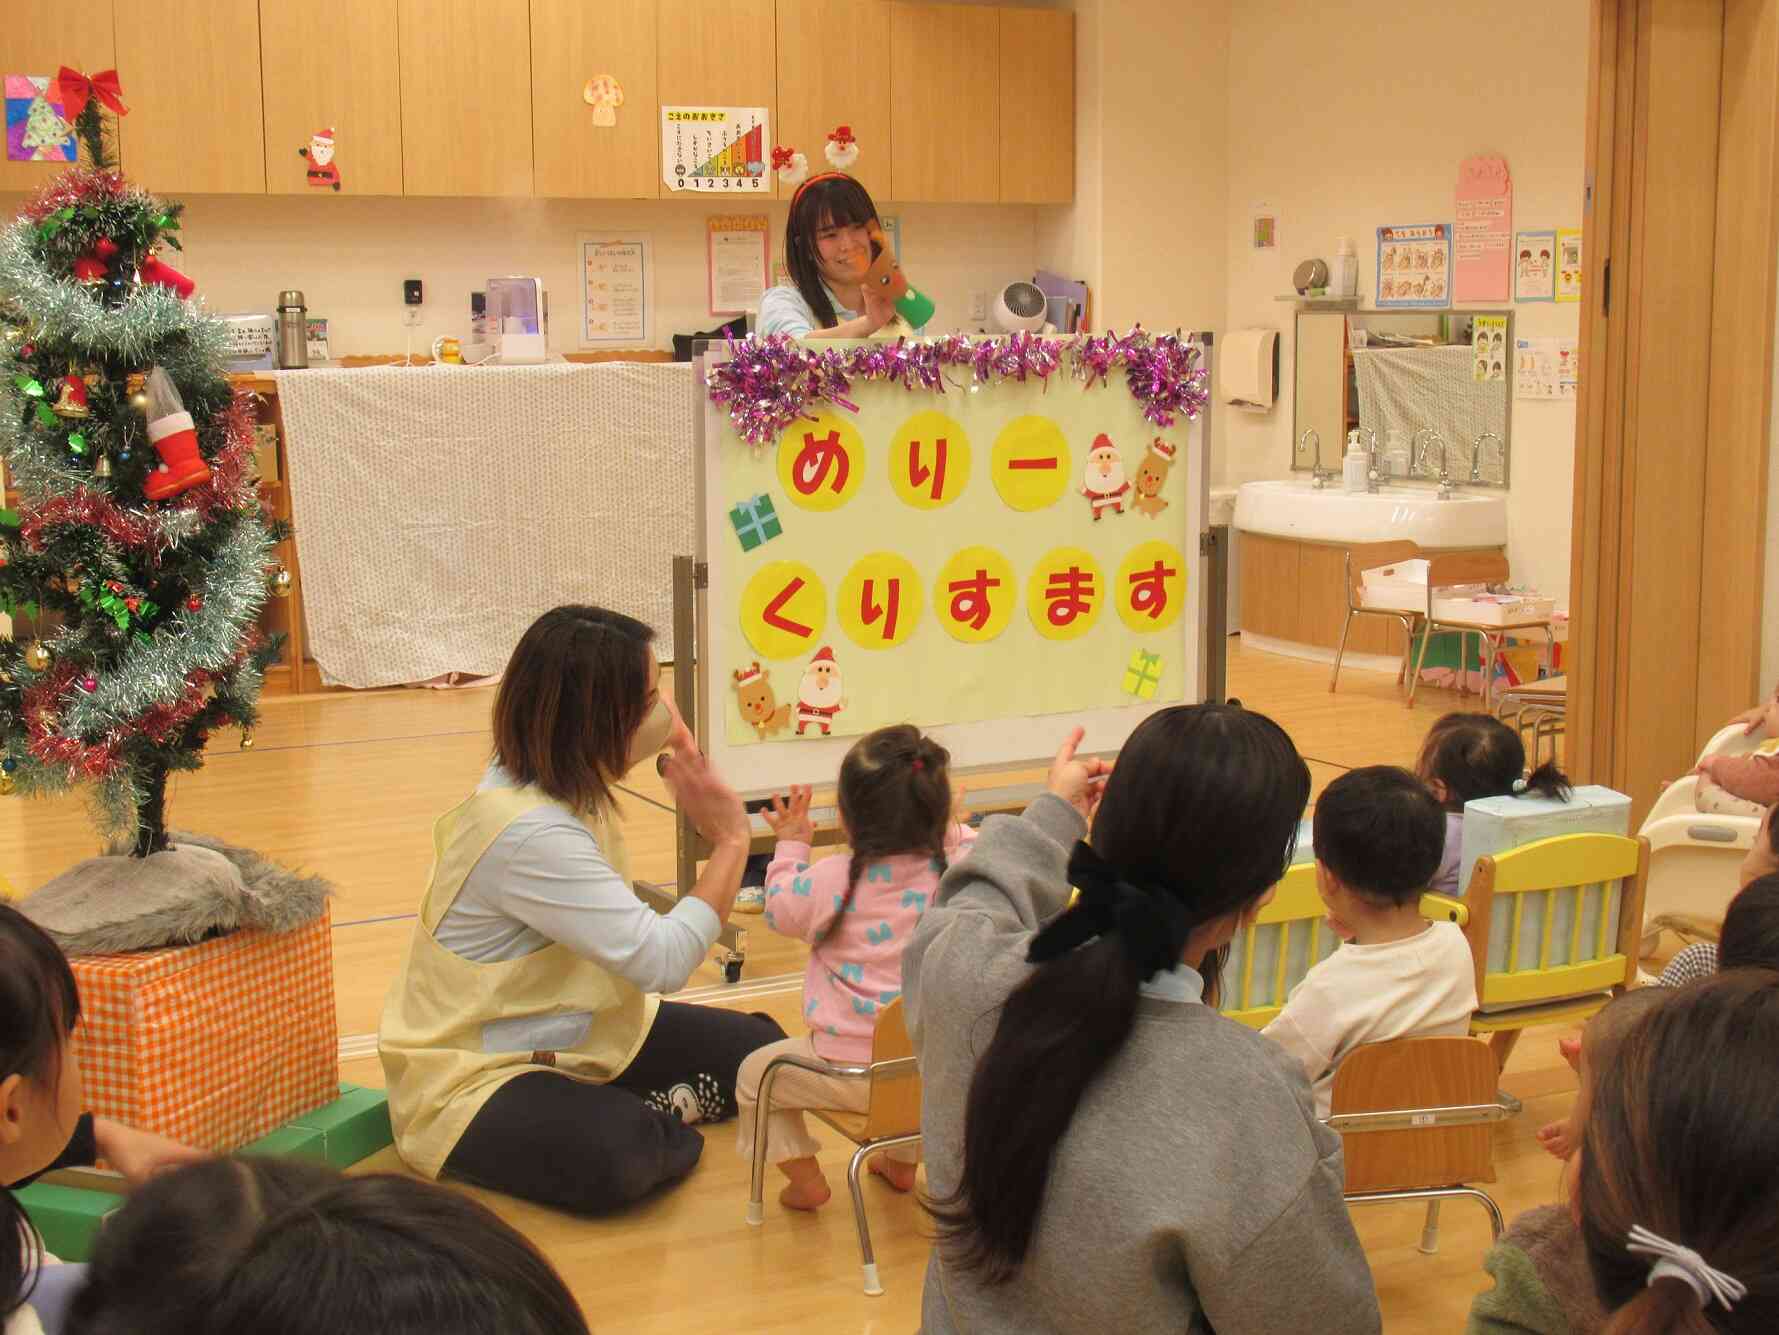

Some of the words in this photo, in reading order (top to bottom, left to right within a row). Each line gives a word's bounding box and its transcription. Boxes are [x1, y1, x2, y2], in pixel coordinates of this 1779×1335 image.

[668, 112, 725, 121] こえのおおきさ
[678, 178, 685, 188] 0
[694, 178, 700, 188] 1
[708, 178, 715, 188] 2
[722, 178, 729, 188] 3
[736, 178, 743, 188] 4
[752, 178, 759, 188] 5
[792, 429, 1058, 500] めりー
[762, 559, 1177, 640] くりすます
